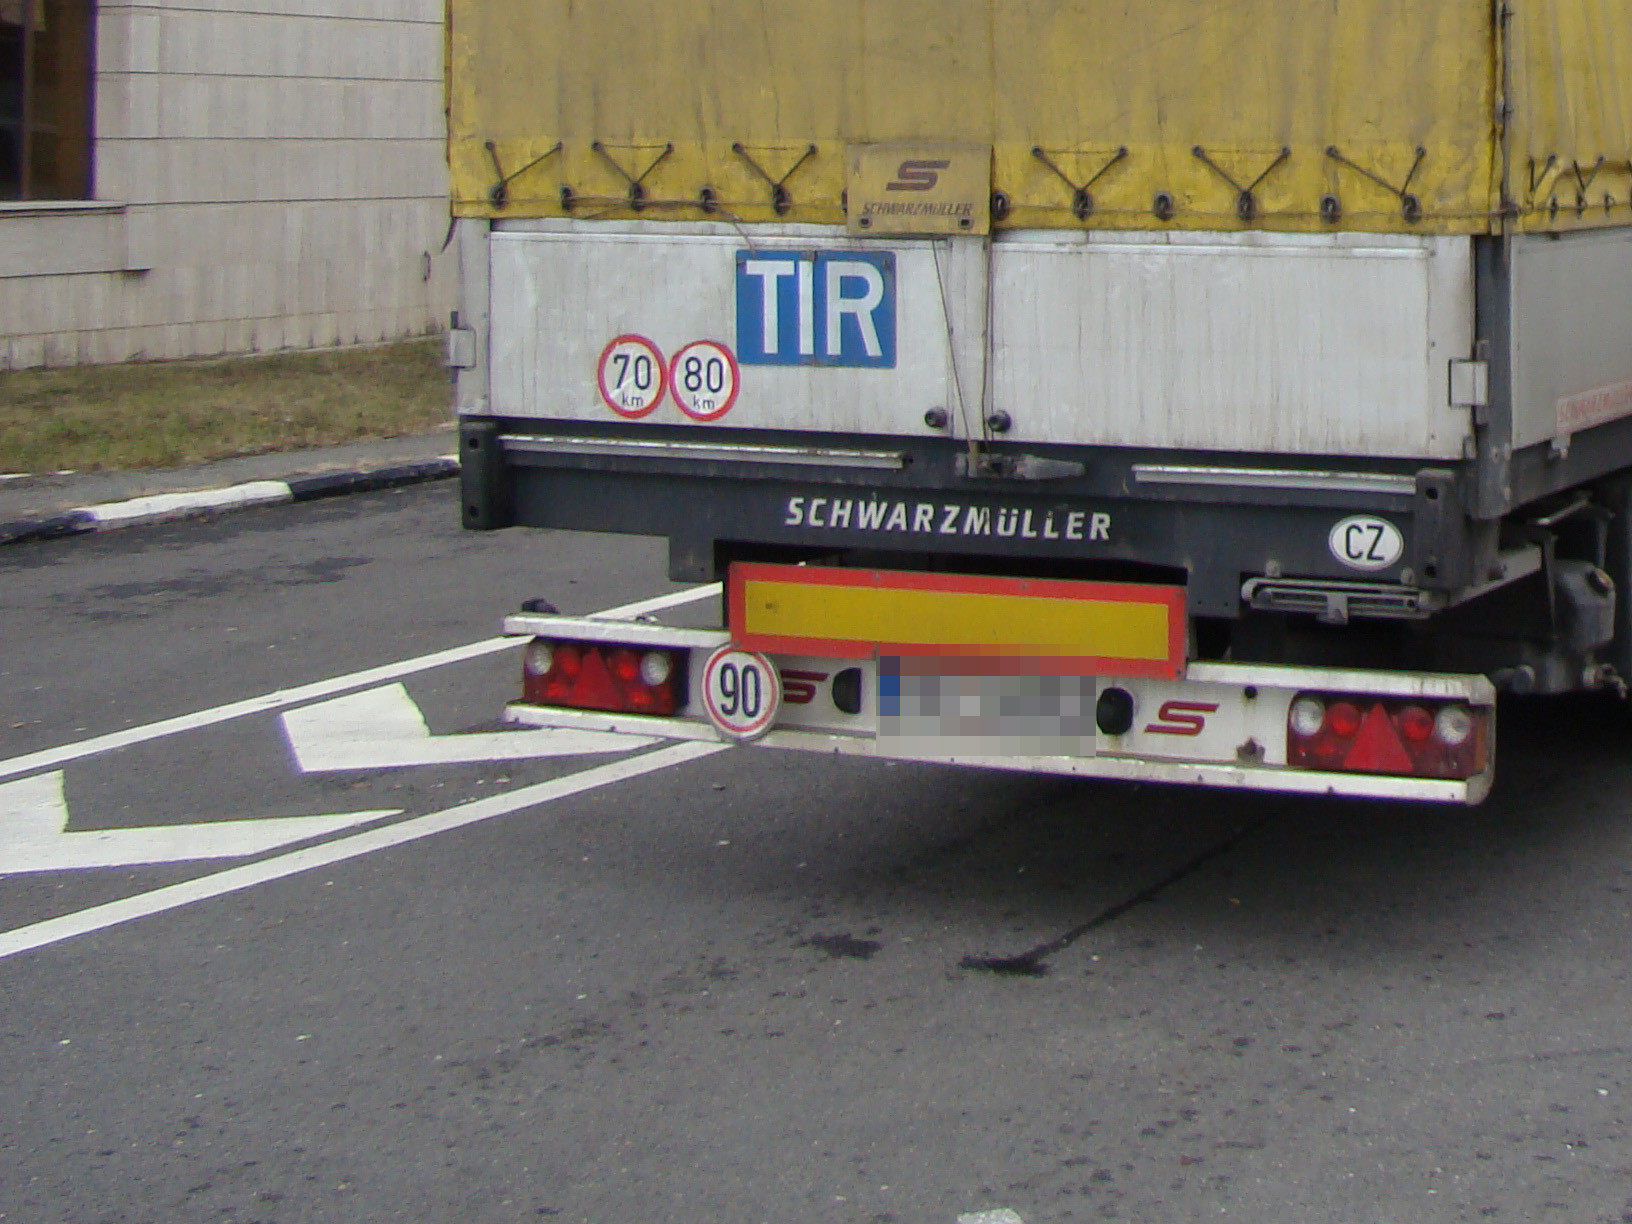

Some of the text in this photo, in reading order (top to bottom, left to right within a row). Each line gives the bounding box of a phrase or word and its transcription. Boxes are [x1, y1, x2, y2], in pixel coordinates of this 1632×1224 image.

[746, 259, 883, 357] TIR
[612, 353, 652, 391] 70
[684, 355, 724, 393] 80
[622, 392, 644, 408] km
[693, 396, 715, 410] km
[784, 495, 1113, 542] SCHWARZMÜLLER
[1342, 522, 1387, 562] CZ
[717, 663, 761, 719] 90
